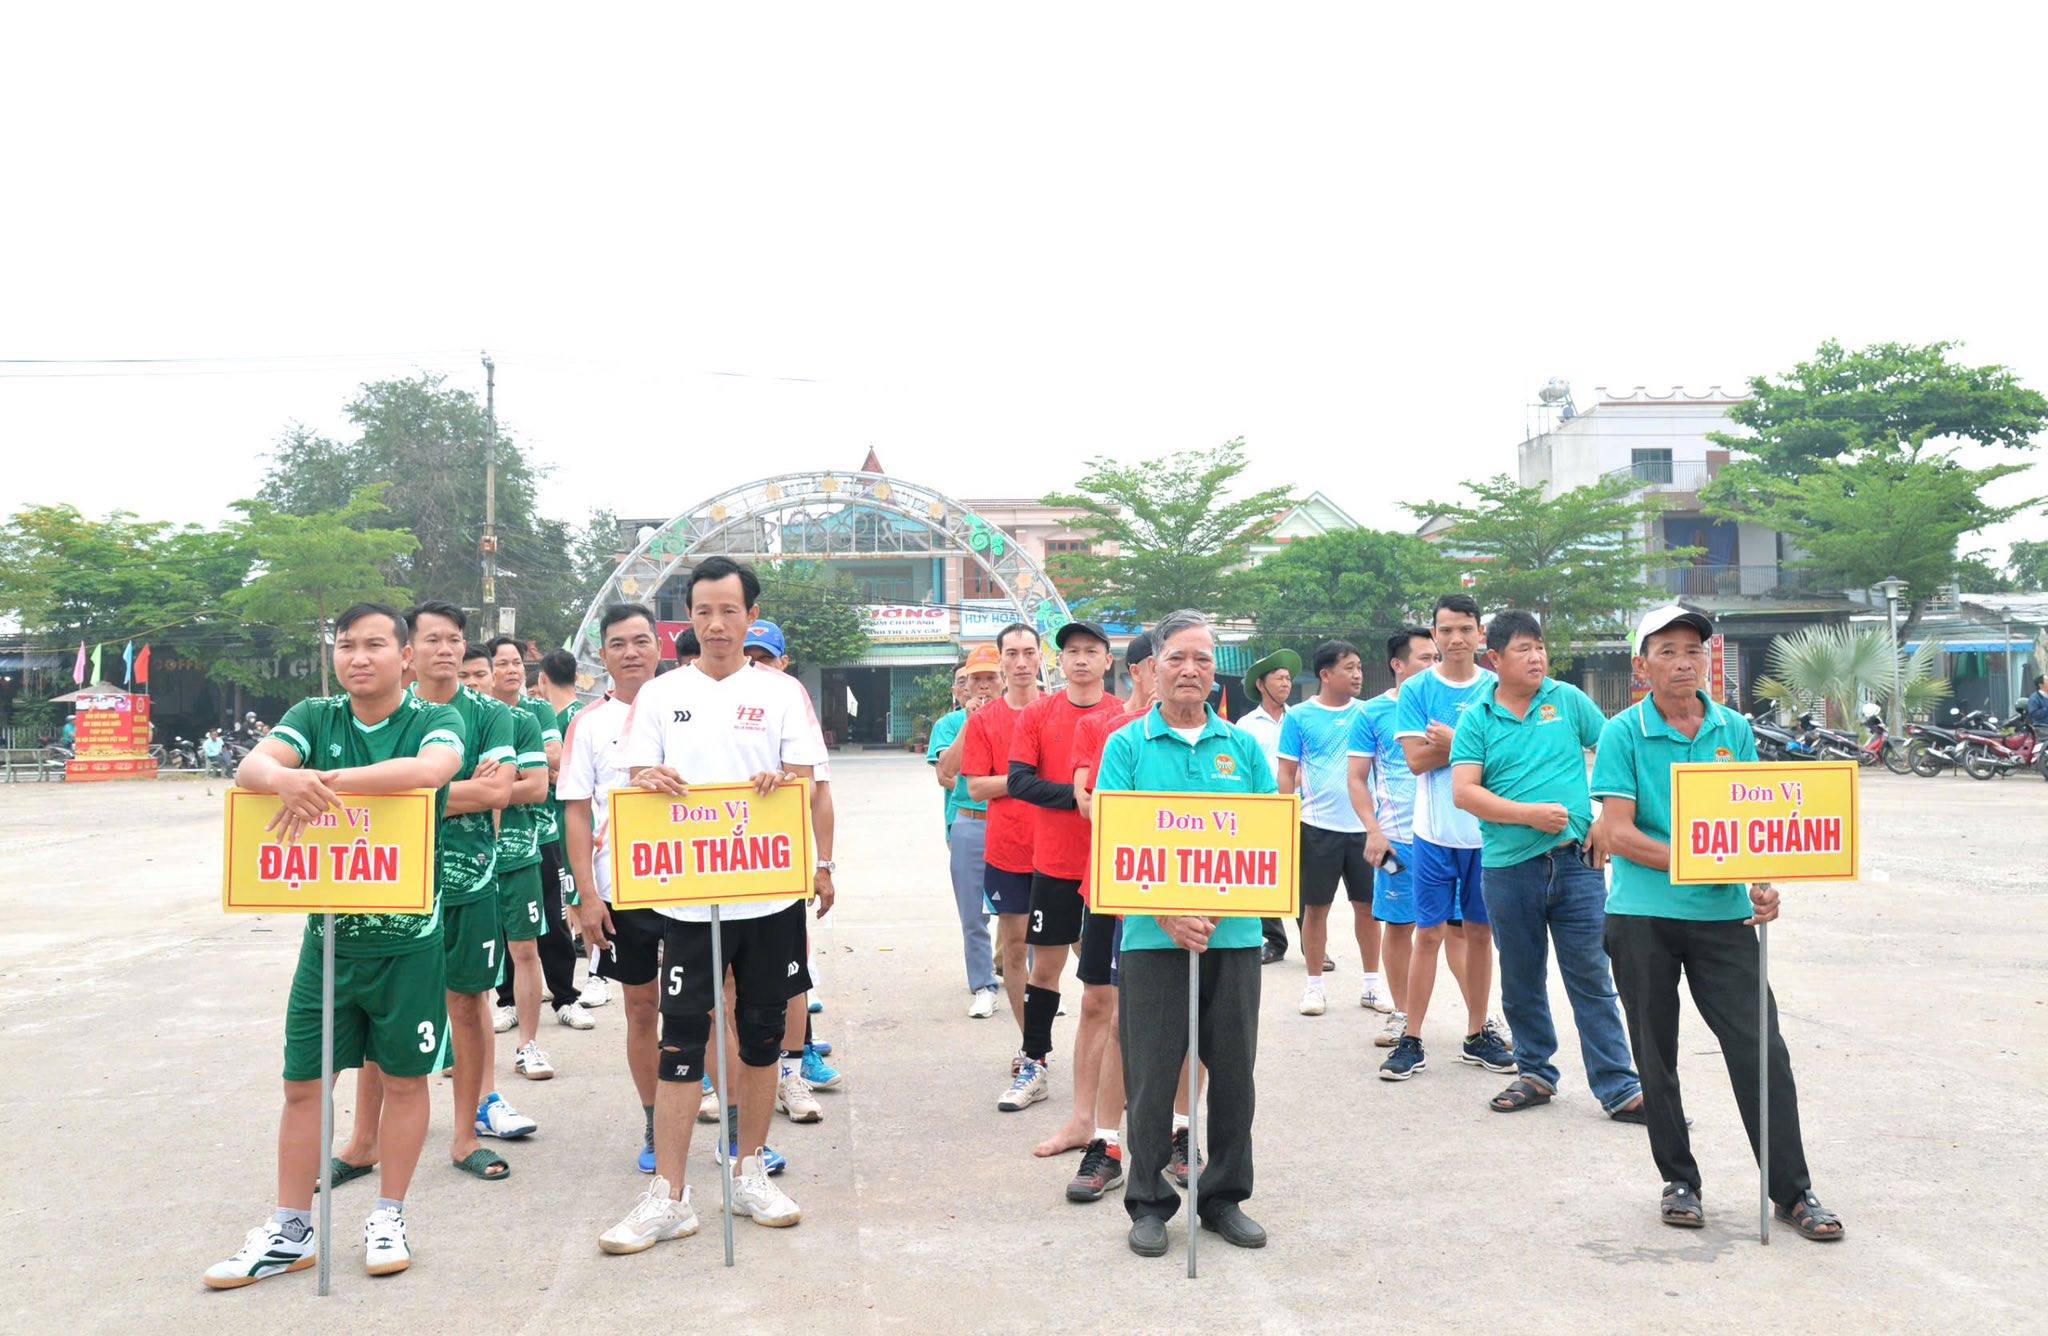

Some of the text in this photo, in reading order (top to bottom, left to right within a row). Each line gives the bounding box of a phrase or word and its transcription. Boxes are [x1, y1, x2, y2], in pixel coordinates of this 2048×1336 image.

[965, 613, 988, 624] HUY
[1731, 782, 1802, 805] Đơn Vị
[345, 808, 370, 832] Vị
[671, 801, 749, 824] Đơn Vị
[1157, 810, 1237, 836] Đơn Vị
[1691, 811, 1840, 862] ĐẠI CHÁNH
[259, 838, 399, 889] ĐẠI TÂN
[632, 824, 791, 883] ĐẠI THẮNG
[1115, 847, 1277, 893] ĐẠI THẠNH
[527, 900, 540, 923] 5
[1032, 909, 1044, 933] 3
[482, 939, 496, 968] 7
[417, 1020, 436, 1053] 3
